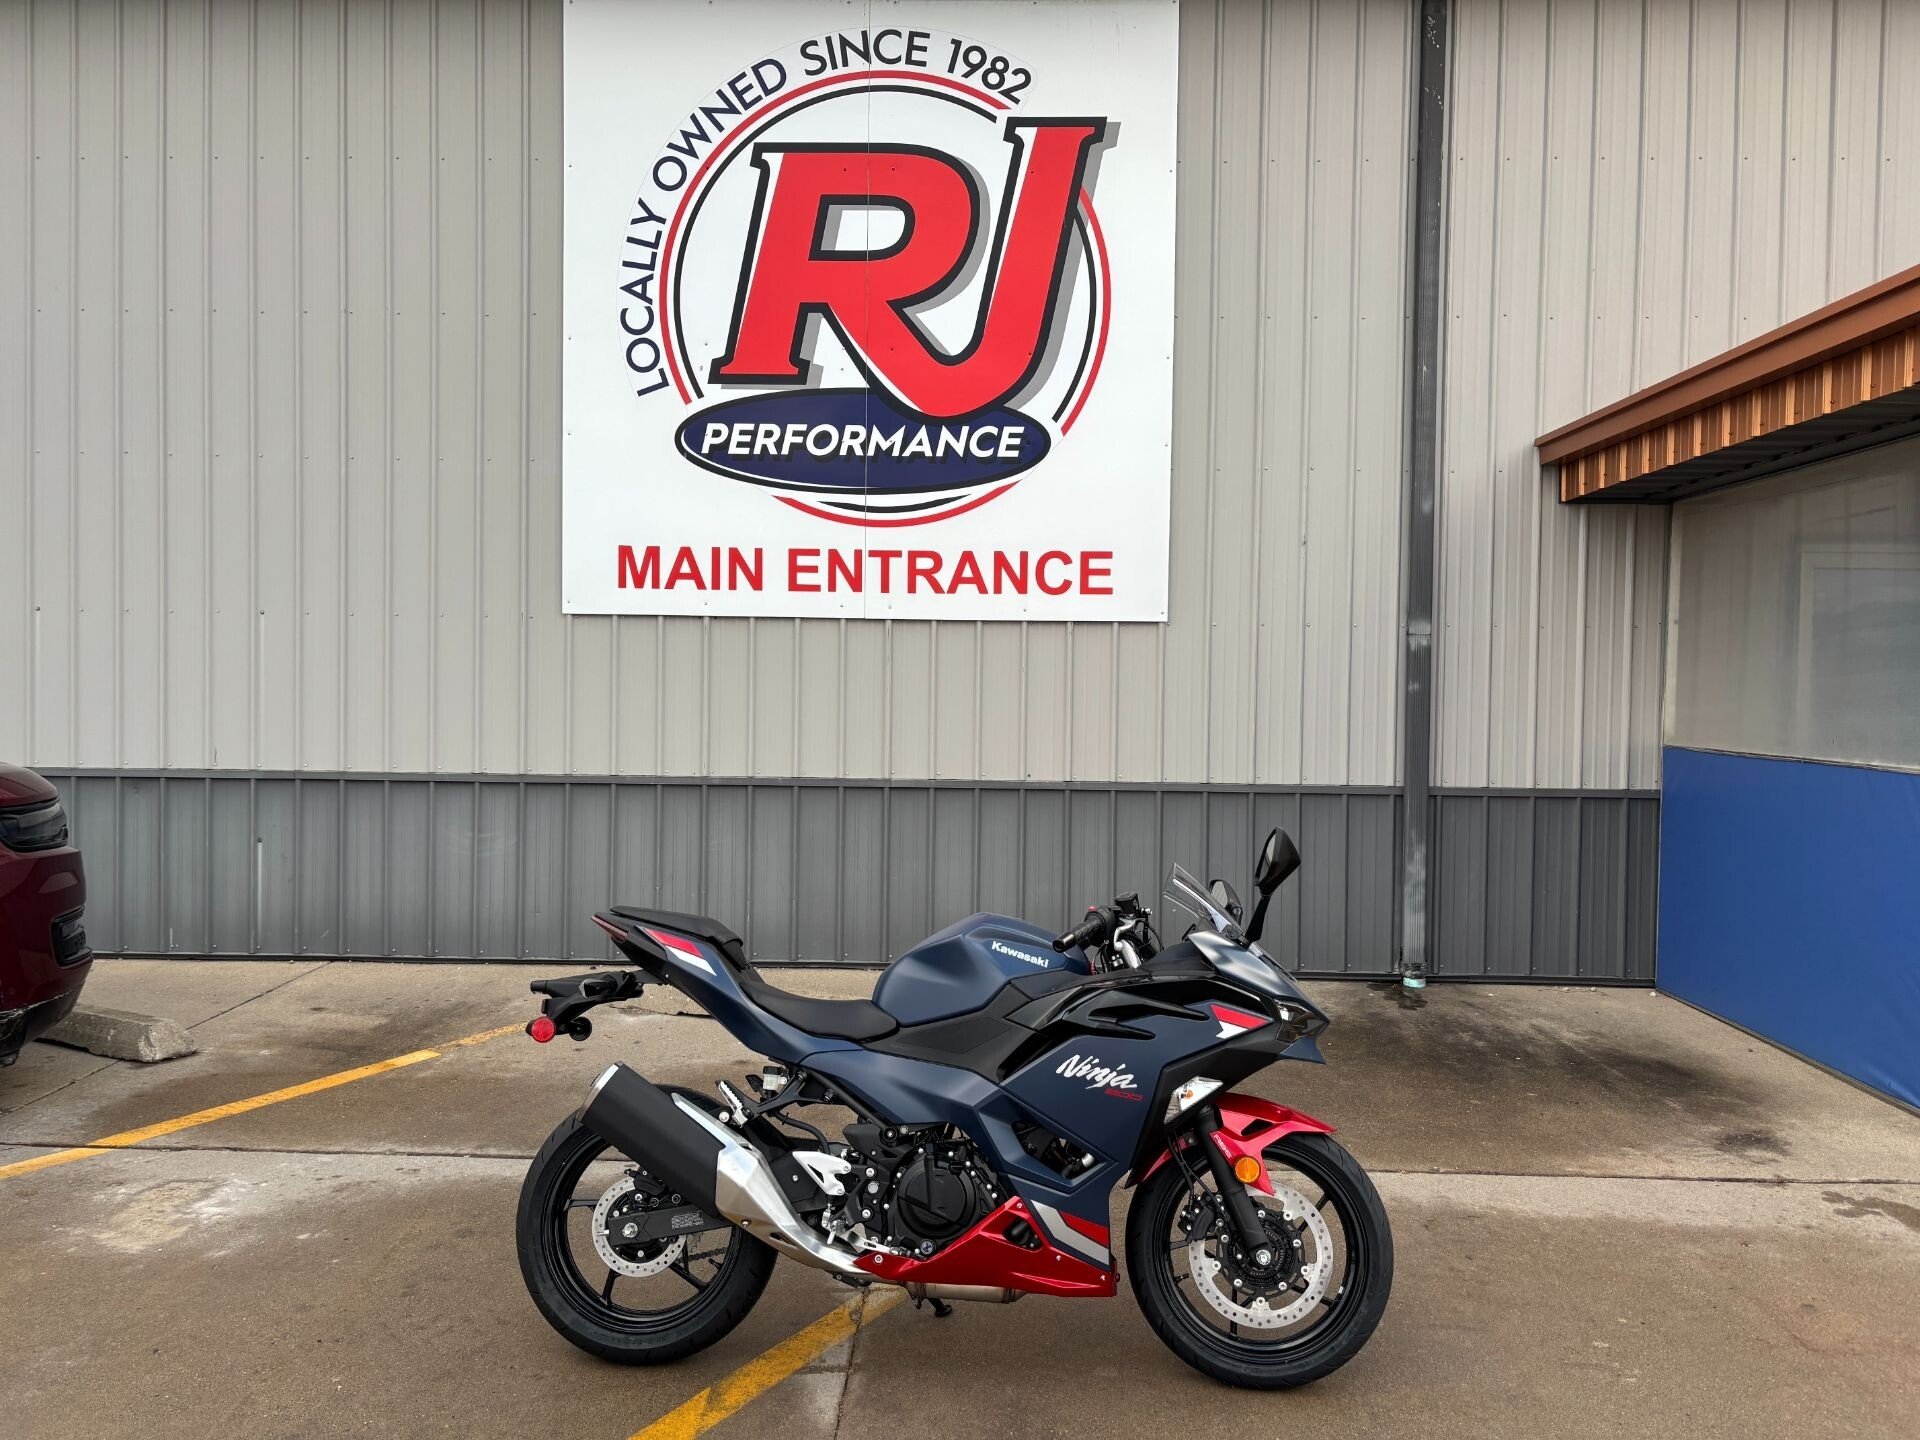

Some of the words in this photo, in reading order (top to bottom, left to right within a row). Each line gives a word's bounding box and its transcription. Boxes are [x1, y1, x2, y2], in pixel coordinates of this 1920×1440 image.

[619, 197, 670, 397] LOCALLY
[652, 58, 787, 192] OWNED
[799, 28, 931, 77] SINCE
[947, 37, 1032, 105] 1982
[708, 116, 1108, 418] RJ
[700, 422, 1026, 459] PERFORMANCE
[617, 545, 763, 592] MAIN
[788, 548, 1113, 596] ENTRANCE
[991, 940, 1049, 968] Kawasaki
[1055, 1054, 1138, 1090] Ninja
